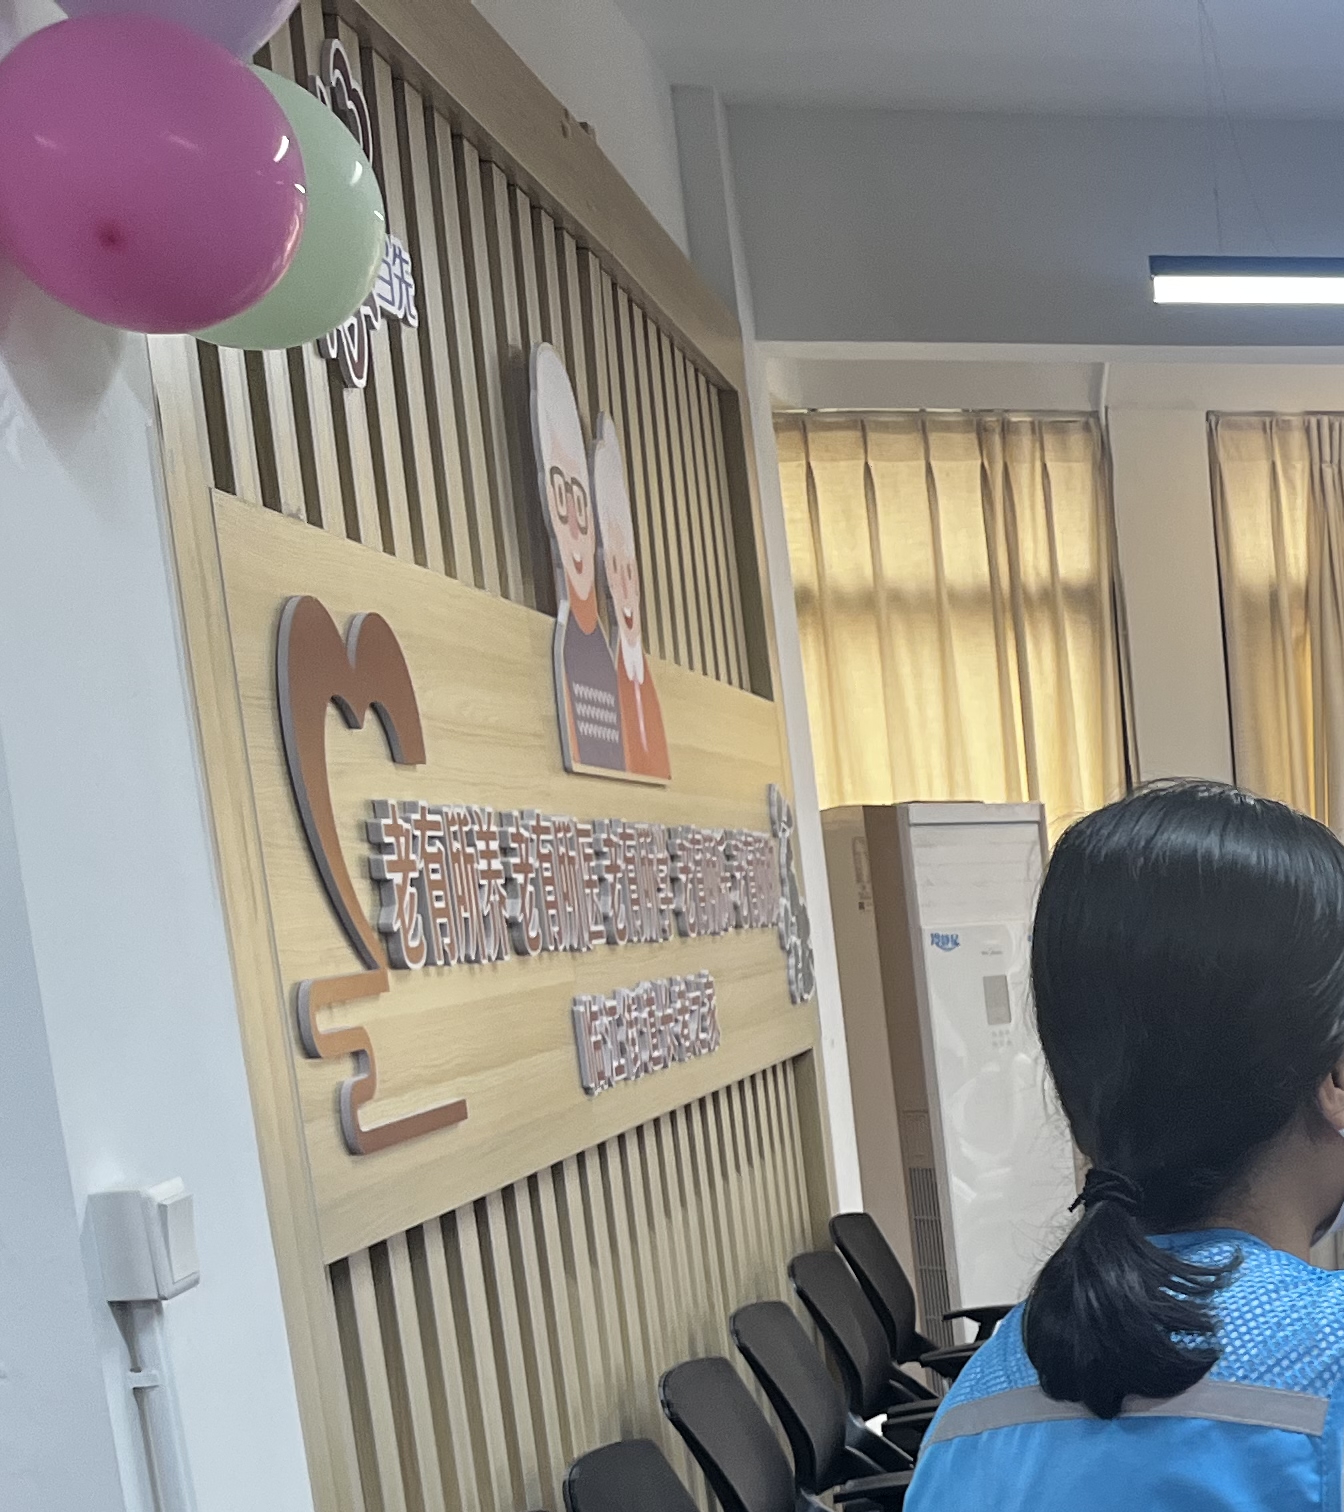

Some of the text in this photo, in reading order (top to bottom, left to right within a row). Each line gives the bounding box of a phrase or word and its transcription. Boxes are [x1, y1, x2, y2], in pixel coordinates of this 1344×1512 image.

[370, 800, 510, 970] 老有所养
[504, 810, 607, 956] 老有所医
